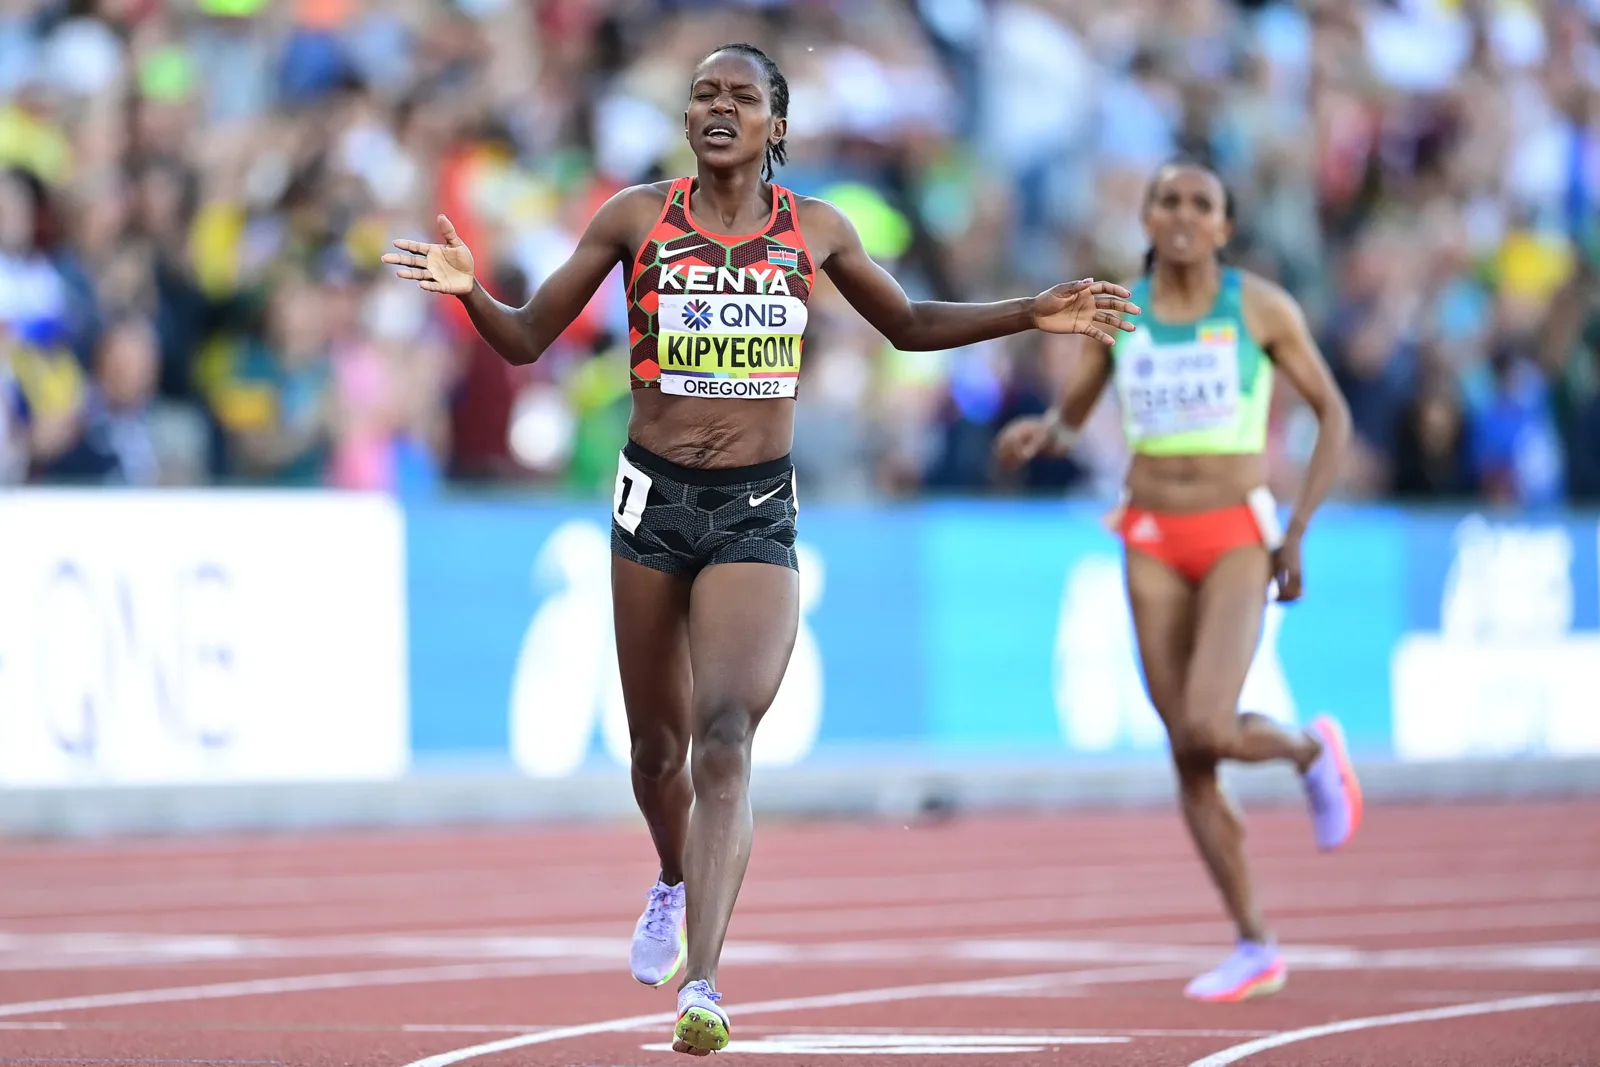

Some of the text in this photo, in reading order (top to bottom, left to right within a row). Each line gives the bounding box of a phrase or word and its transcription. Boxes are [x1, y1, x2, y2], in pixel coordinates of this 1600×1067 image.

[658, 264, 791, 295] KENYA
[719, 303, 787, 328] QNB
[667, 335, 794, 368] KIPYEGON
[683, 379, 780, 396] OREGON22
[617, 475, 634, 516] 1
